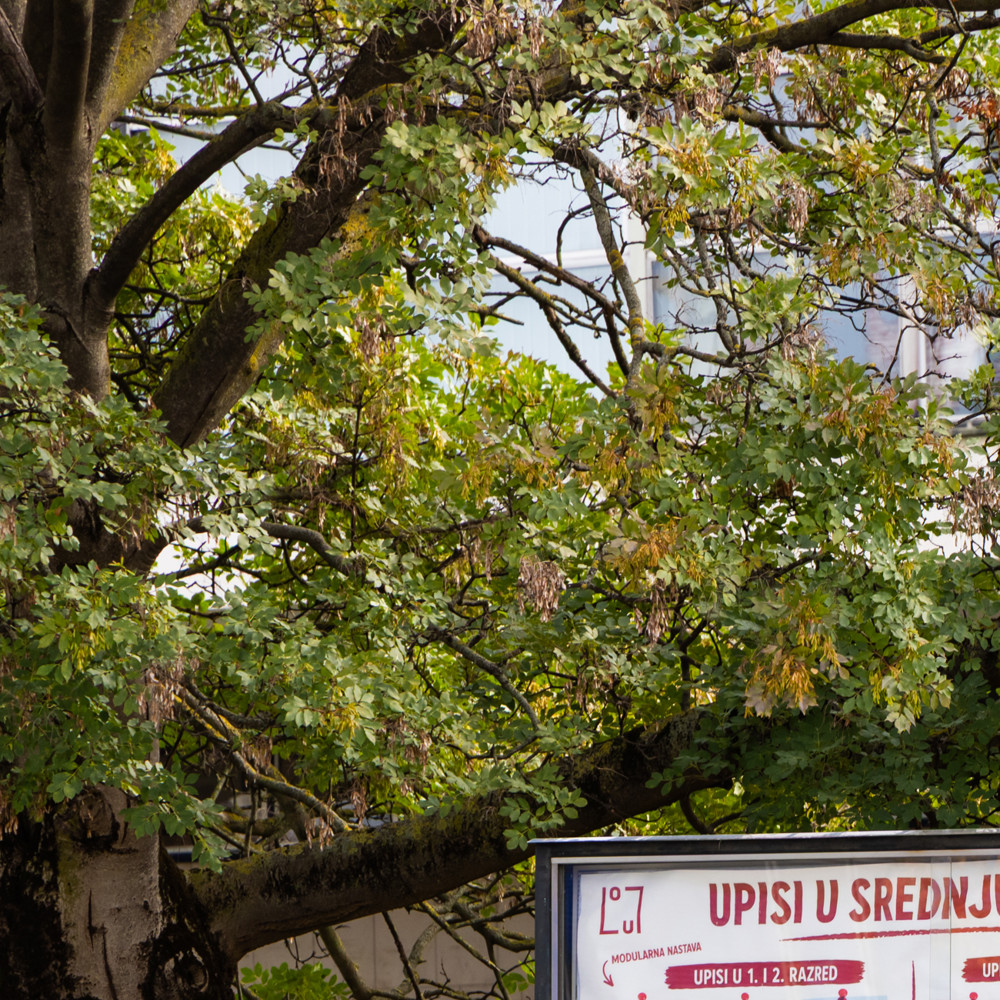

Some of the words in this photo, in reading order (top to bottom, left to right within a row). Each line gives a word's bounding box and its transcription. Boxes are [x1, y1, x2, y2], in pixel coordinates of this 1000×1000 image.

[709, 880, 803, 927] UPISI
[816, 879, 839, 924] U
[611, 948, 666, 964] MODULARNA
[667, 942, 702, 956] NASTAVA
[694, 968, 728, 985] UPISI
[732, 968, 742, 984] U
[748, 968, 758, 984] 1.
[763, 968, 767, 984] I
[772, 967, 785, 983] 2.
[789, 966, 838, 982] RAZRED
